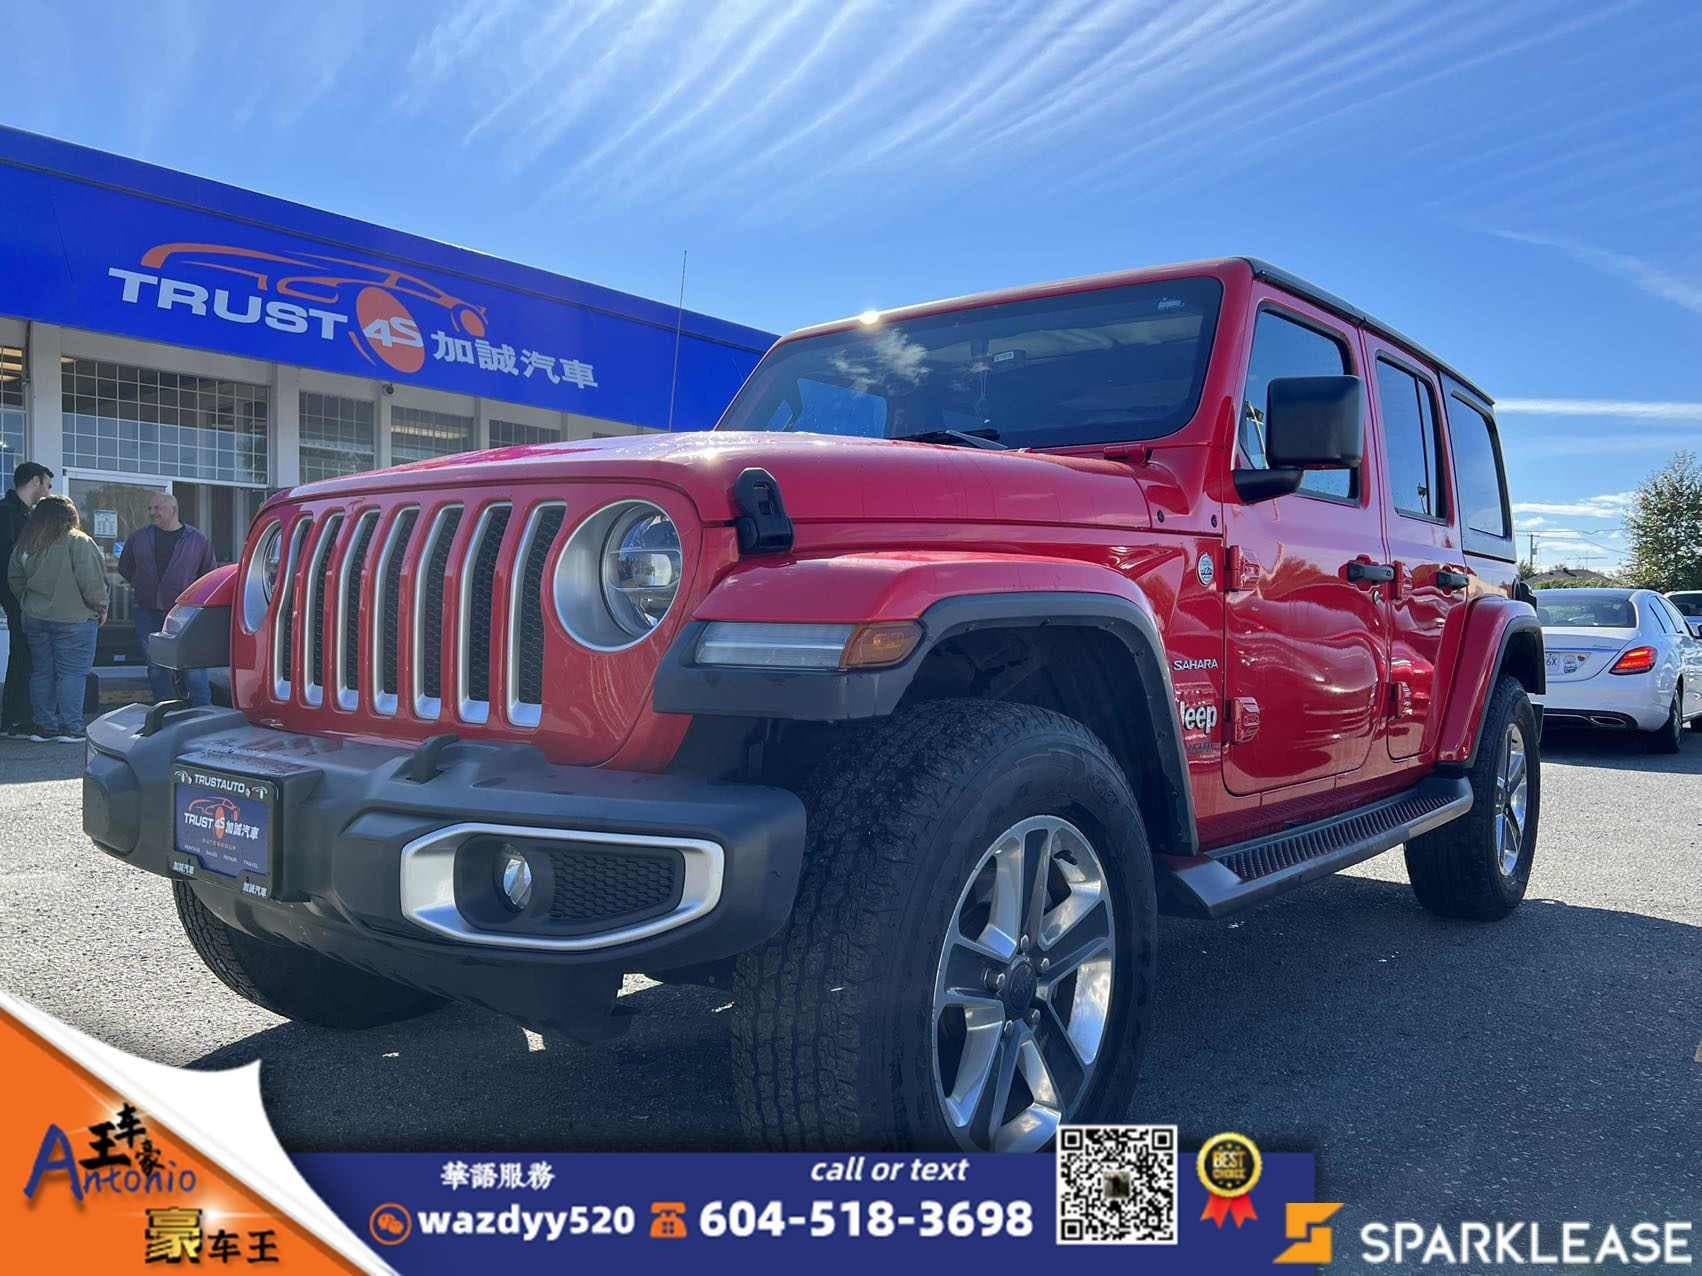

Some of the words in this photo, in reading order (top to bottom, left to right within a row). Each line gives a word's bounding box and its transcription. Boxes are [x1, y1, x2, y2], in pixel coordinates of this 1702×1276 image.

[108, 267, 349, 341] TRUST
[362, 316, 425, 349] 4S
[430, 330, 599, 390] 加誠汽車
[1173, 658, 1219, 671] SAHARA
[195, 774, 245, 793] TRUSTAUTO
[184, 813, 214, 829] TRUST
